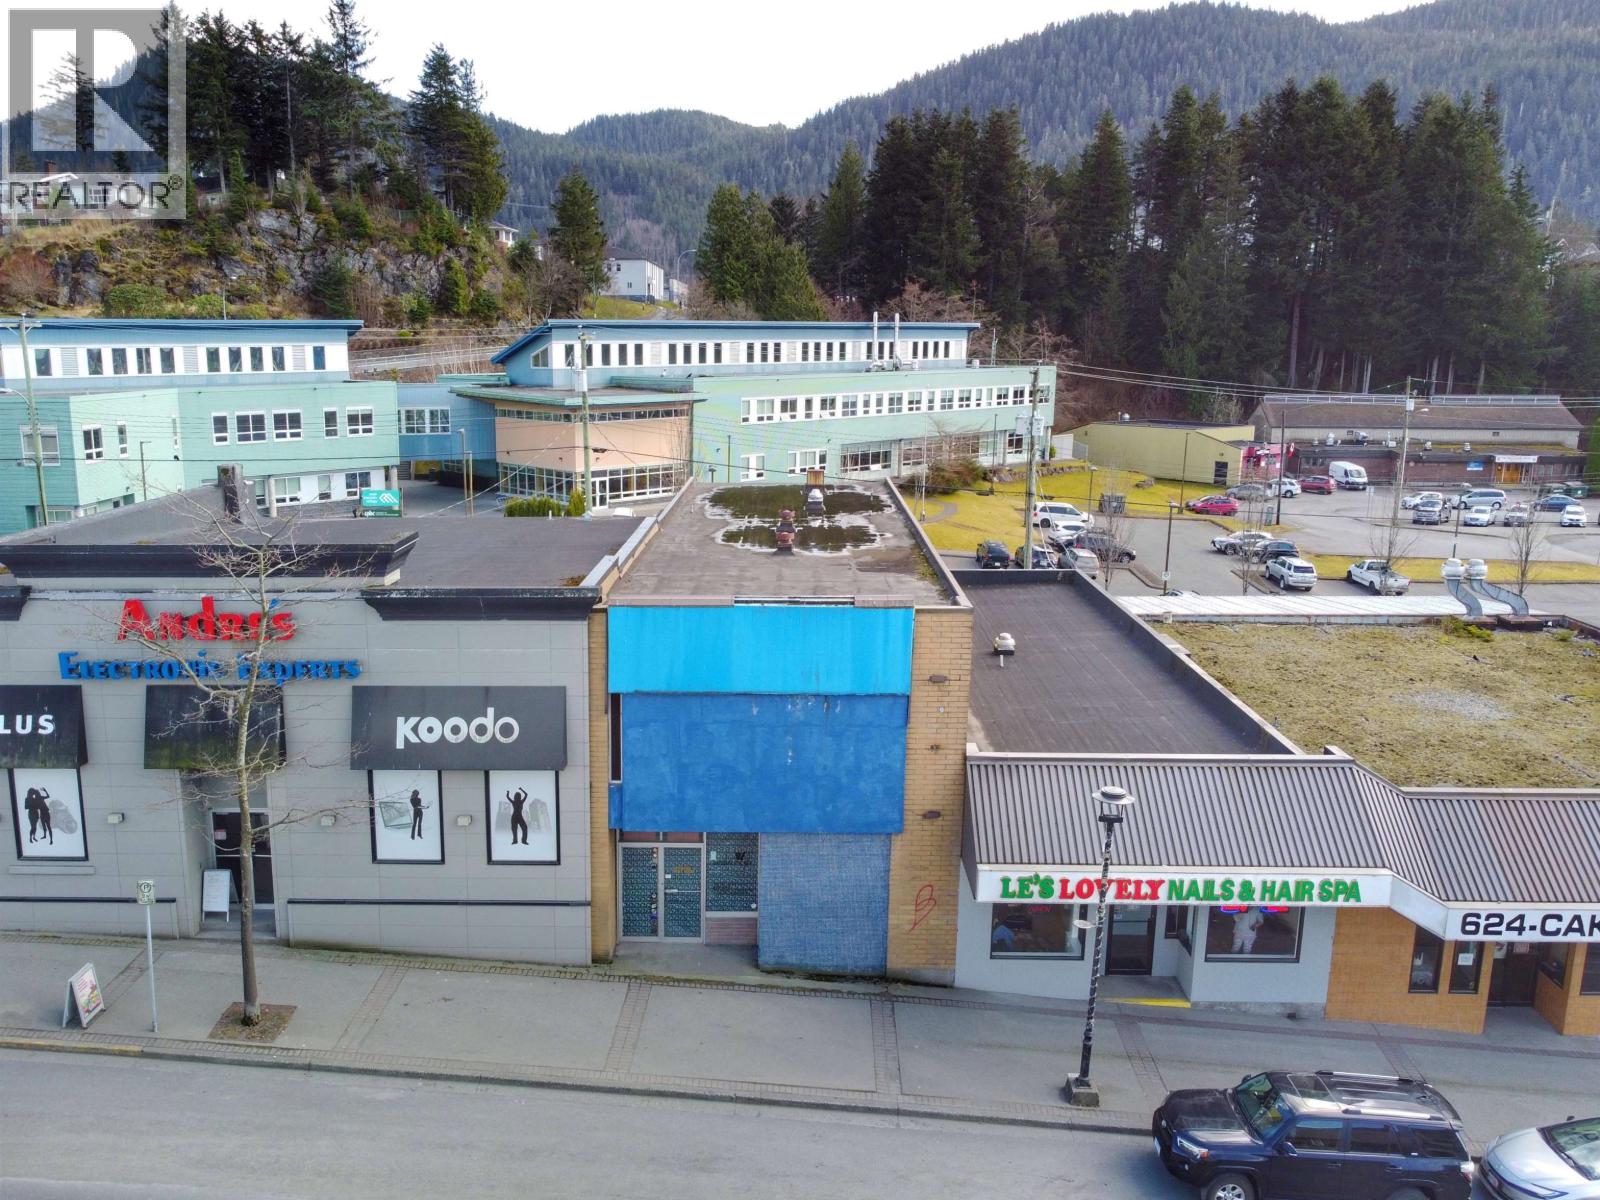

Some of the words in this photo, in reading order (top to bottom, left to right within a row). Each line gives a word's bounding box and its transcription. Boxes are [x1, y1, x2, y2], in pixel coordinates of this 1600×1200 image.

[1000, 874, 1055, 900] LE'S
[1167, 878, 1236, 902] NAILS
[1237, 879, 1257, 902] &
[1259, 880, 1316, 902] HAIR
[1318, 879, 1362, 903] SPA
